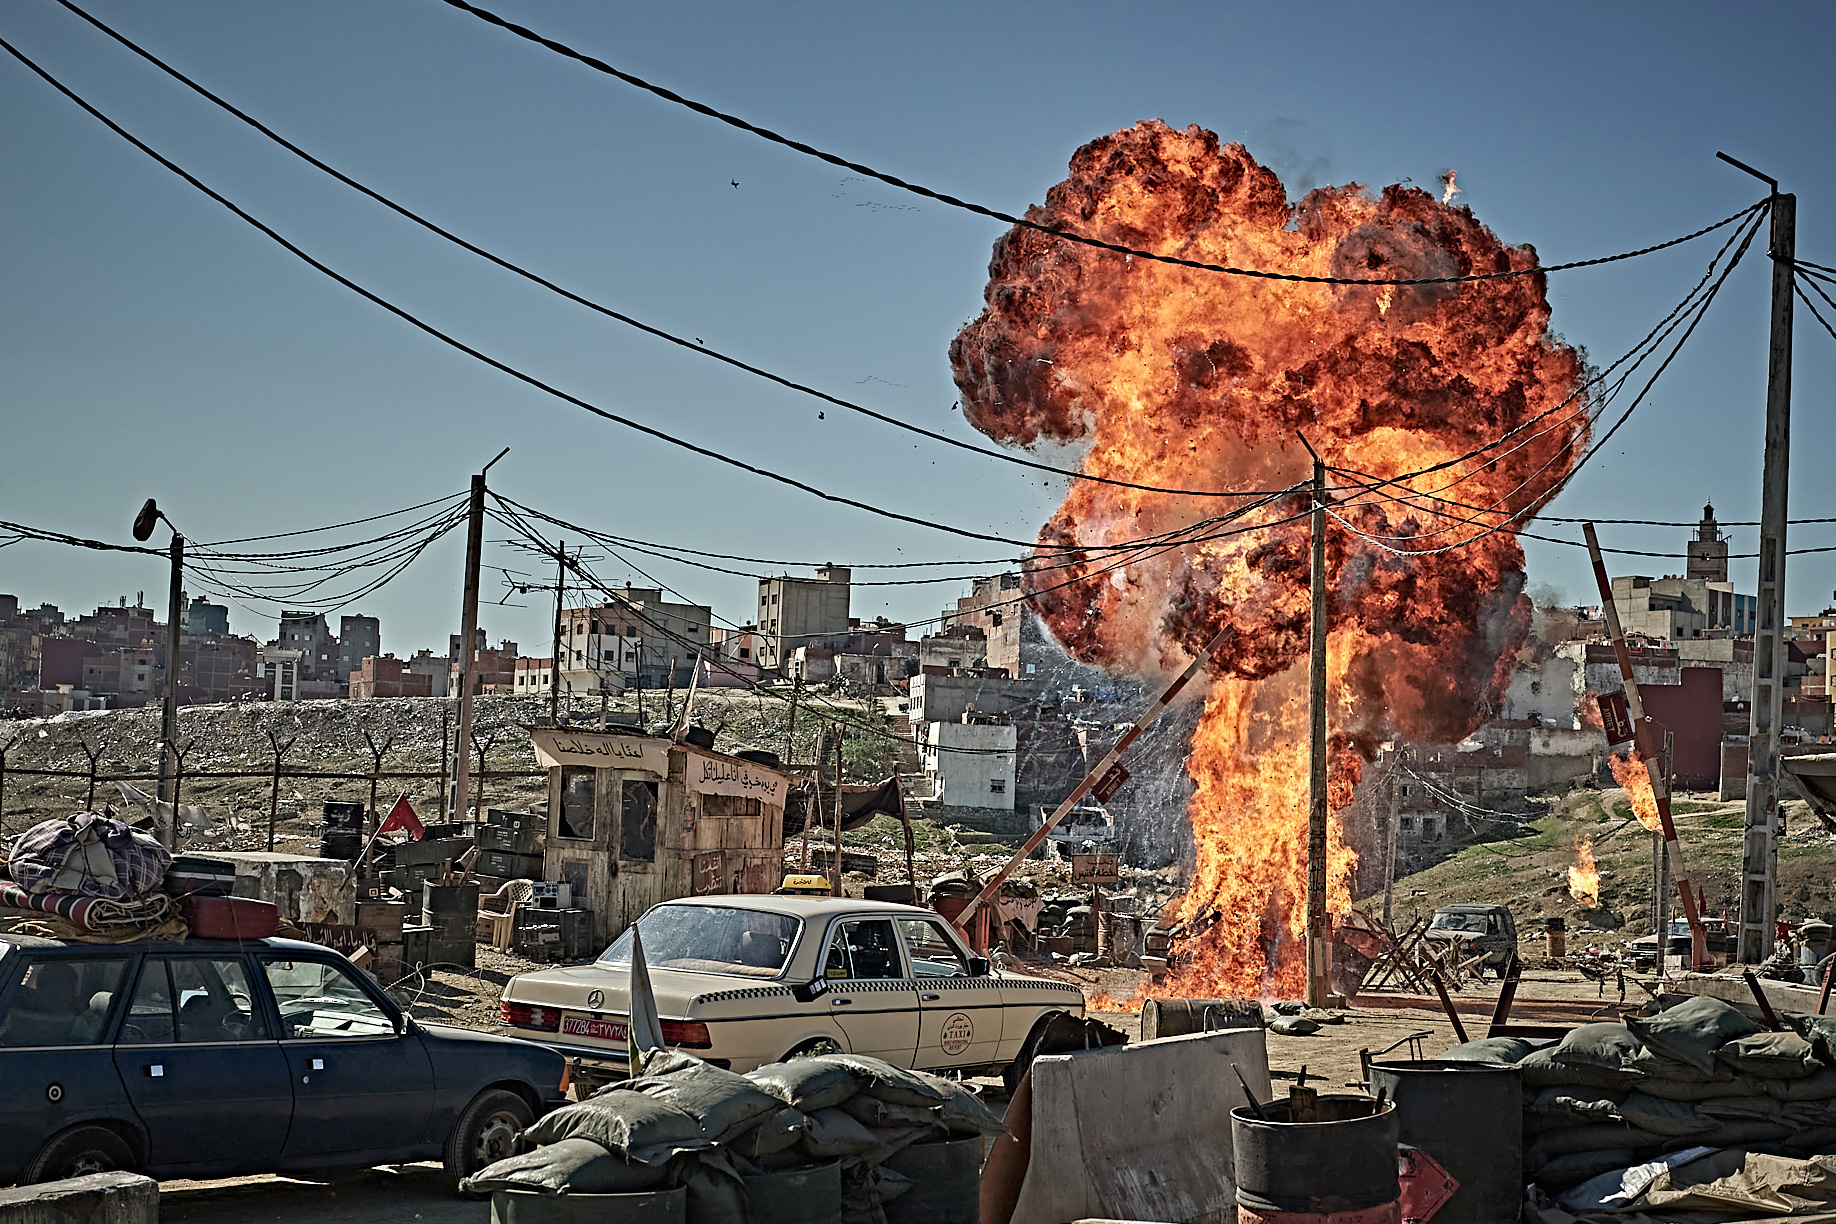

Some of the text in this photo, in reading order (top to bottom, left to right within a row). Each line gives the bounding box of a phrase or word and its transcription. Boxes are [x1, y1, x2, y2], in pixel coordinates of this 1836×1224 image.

[553, 737, 596, 756] خلاصنا
[563, 1017, 590, 1035] 377284
[949, 1030, 966, 1039] TAXI
